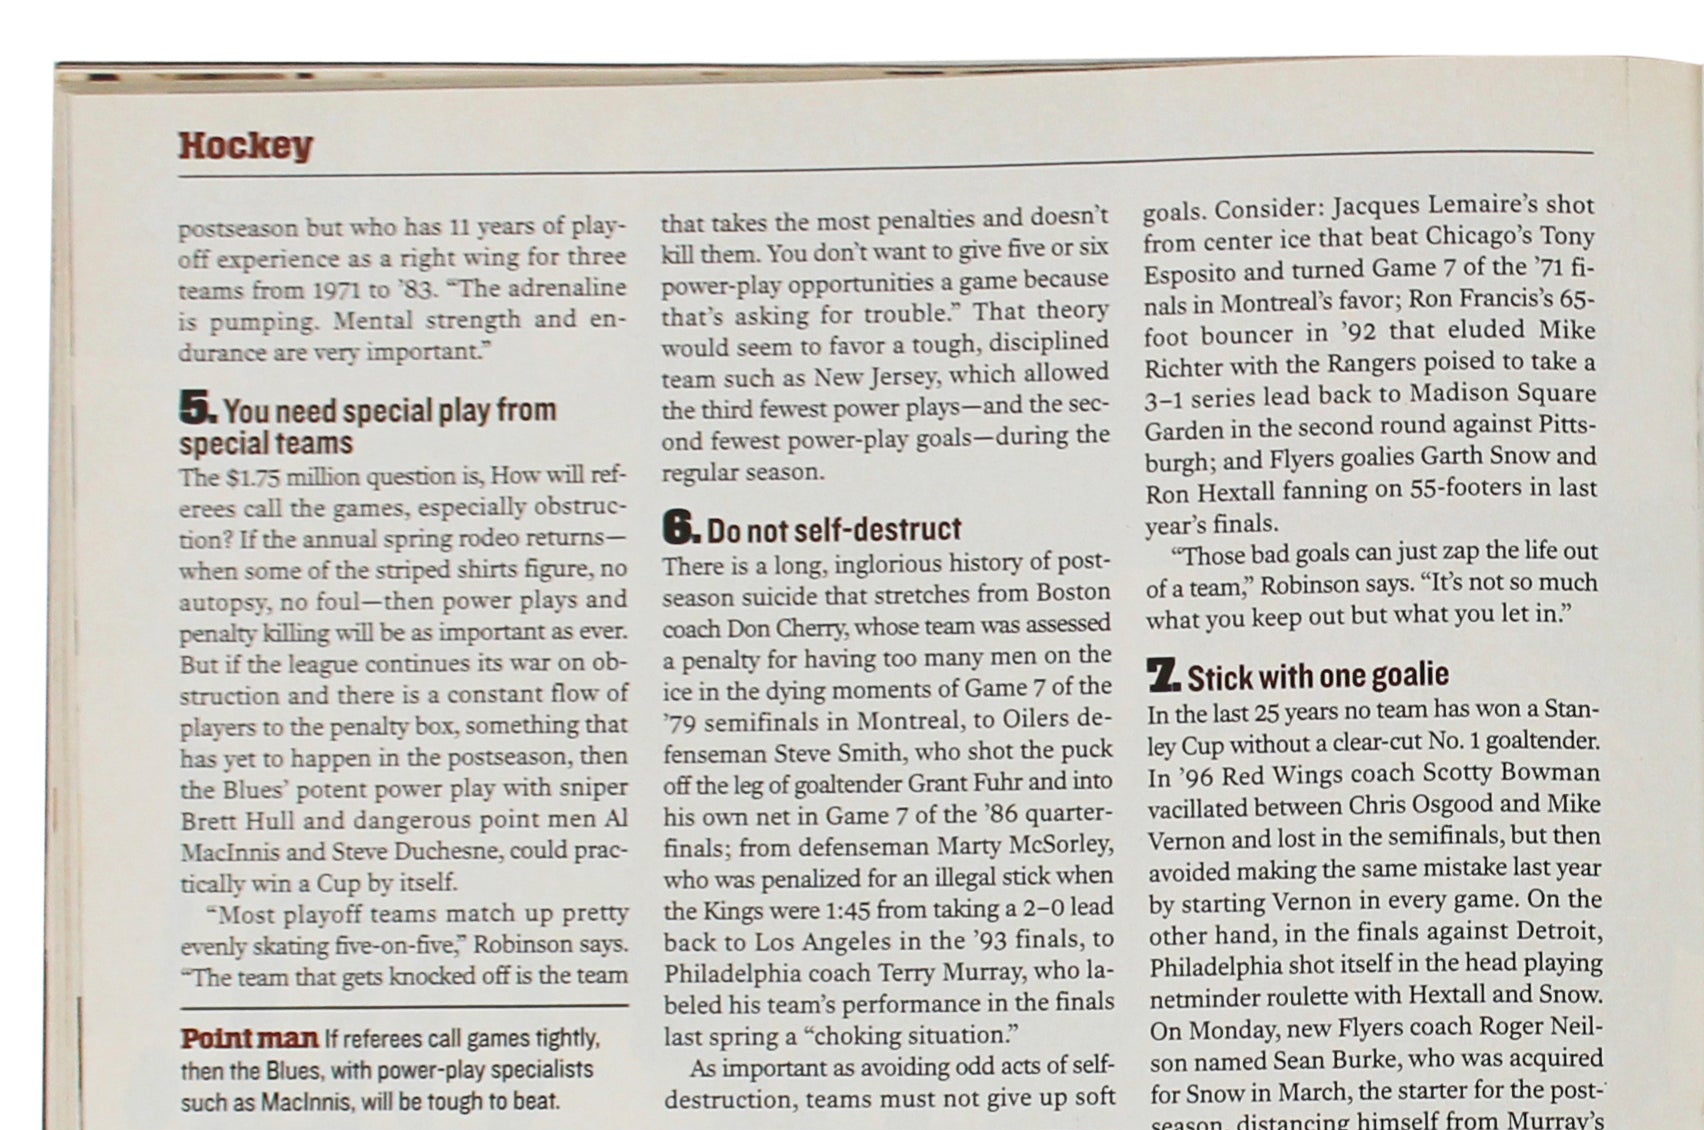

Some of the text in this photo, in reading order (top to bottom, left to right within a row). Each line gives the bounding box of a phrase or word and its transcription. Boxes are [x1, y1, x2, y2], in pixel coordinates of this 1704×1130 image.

[178, 131, 313, 163] Hockey
[1143, 193, 1594, 227] goals. Consider: Jacques Lemaire's shot
[178, 215, 626, 243] postseason but who has 11 years of play-
[179, 389, 556, 428] 5. You need special play from
[180, 430, 353, 460] special teams
[179, 463, 626, 491] The $1.75 million question is, How will ref-
[663, 508, 962, 545] 6. Do not self-destruct
[1188, 664, 1253, 692] Stick
[1259, 663, 1313, 689] with
[1320, 668, 1366, 688] one
[1372, 660, 1449, 692] goalie
[705, 712, 818, 732] semifinals
[827, 711, 848, 731] in
[858, 709, 966, 732] Montreal,
[974, 713, 995, 728] to
[1003, 708, 1069, 728] Oilers
[1077, 706, 1112, 726] de-
[1149, 769, 1170, 787] In
[1223, 765, 1264, 786] Red
[1273, 765, 1342, 789] Wings
[1351, 762, 1414, 782] coach
[1424, 762, 1492, 786] Scotty
[1501, 762, 1600, 781] Bowman
[664, 901, 697, 920] the
[704, 901, 763, 925] Kings
[770, 906, 820, 919] were
[827, 902, 870, 921] 1:45
[877, 899, 927, 919] from
[933, 898, 1000, 923] taking
[1006, 903, 1017, 917] a
[1071, 895, 1114, 916] lead
[181, 1027, 599, 1052] Point man If referees call games tightly,
[181, 1059, 593, 1083] then the Blues, with power-play specialists
[182, 1090, 560, 1115] such as MacInnis, will be tough to beat.
